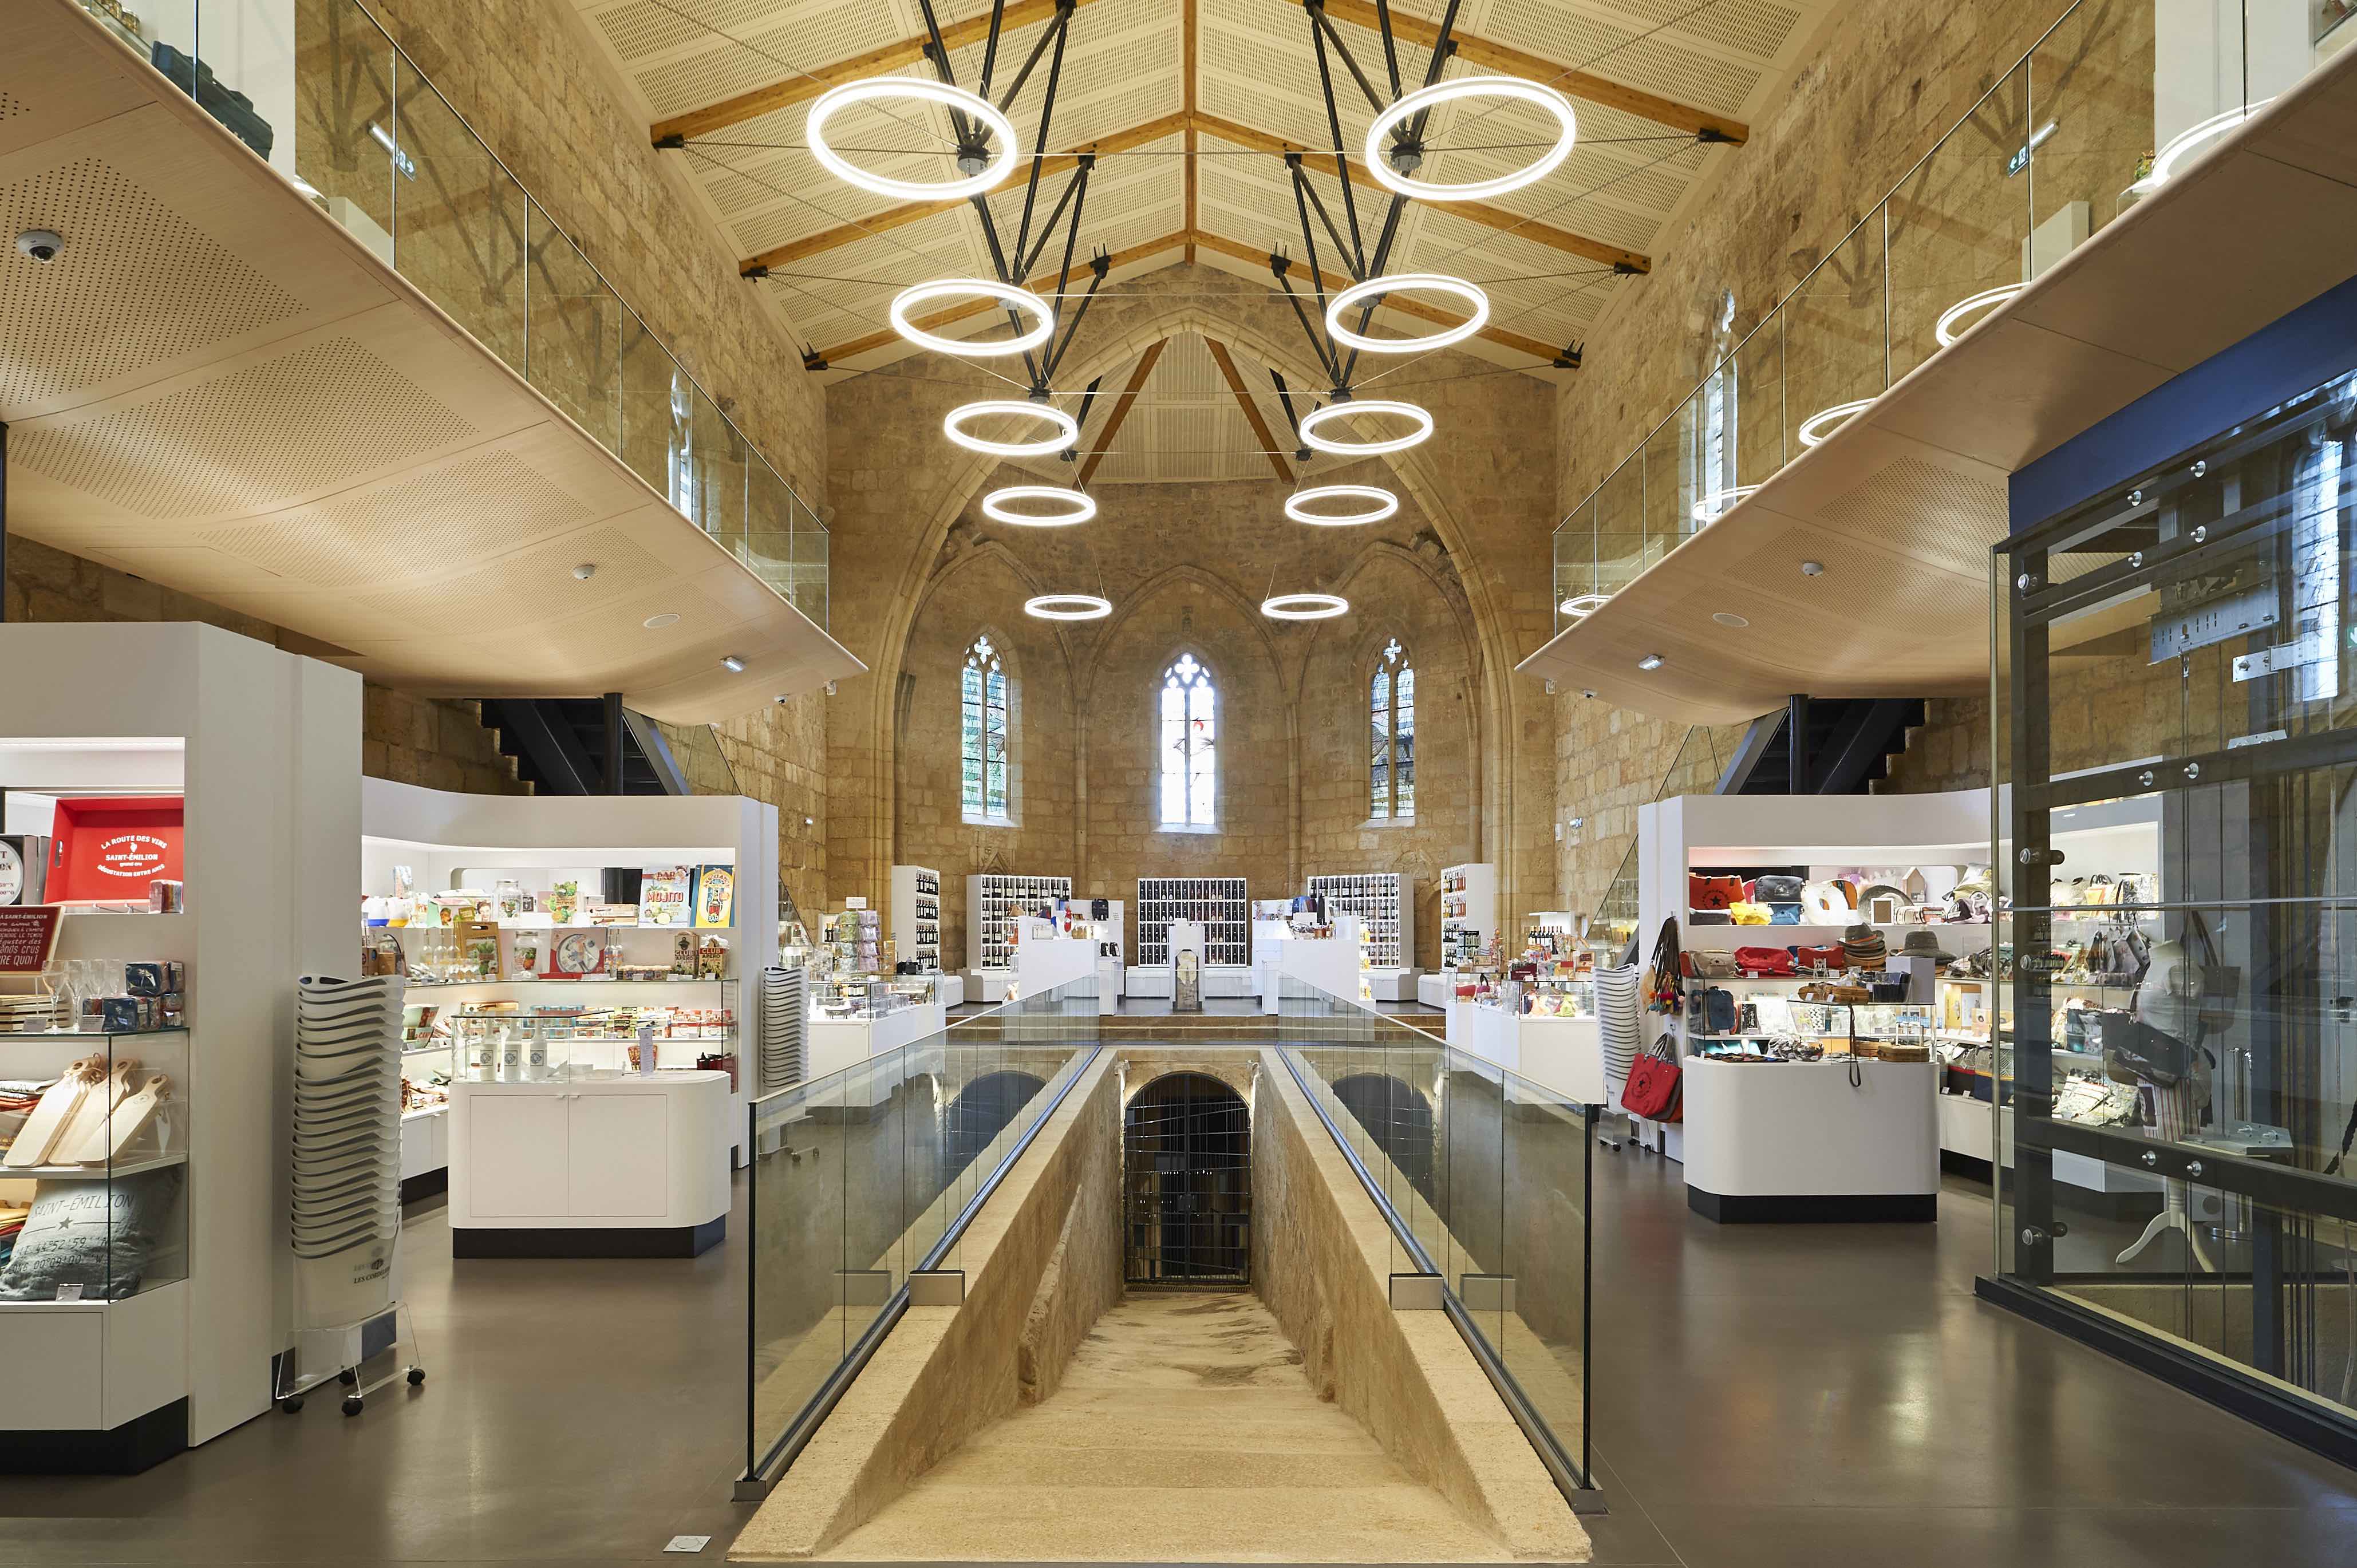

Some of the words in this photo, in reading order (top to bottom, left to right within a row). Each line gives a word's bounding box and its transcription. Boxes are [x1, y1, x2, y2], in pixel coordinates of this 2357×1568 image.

[101, 841, 111, 850] LA
[111, 835, 135, 845] ROUTE
[105, 852, 159, 861] SAINT-ÉMILION
[646, 892, 684, 902] MOJITO
